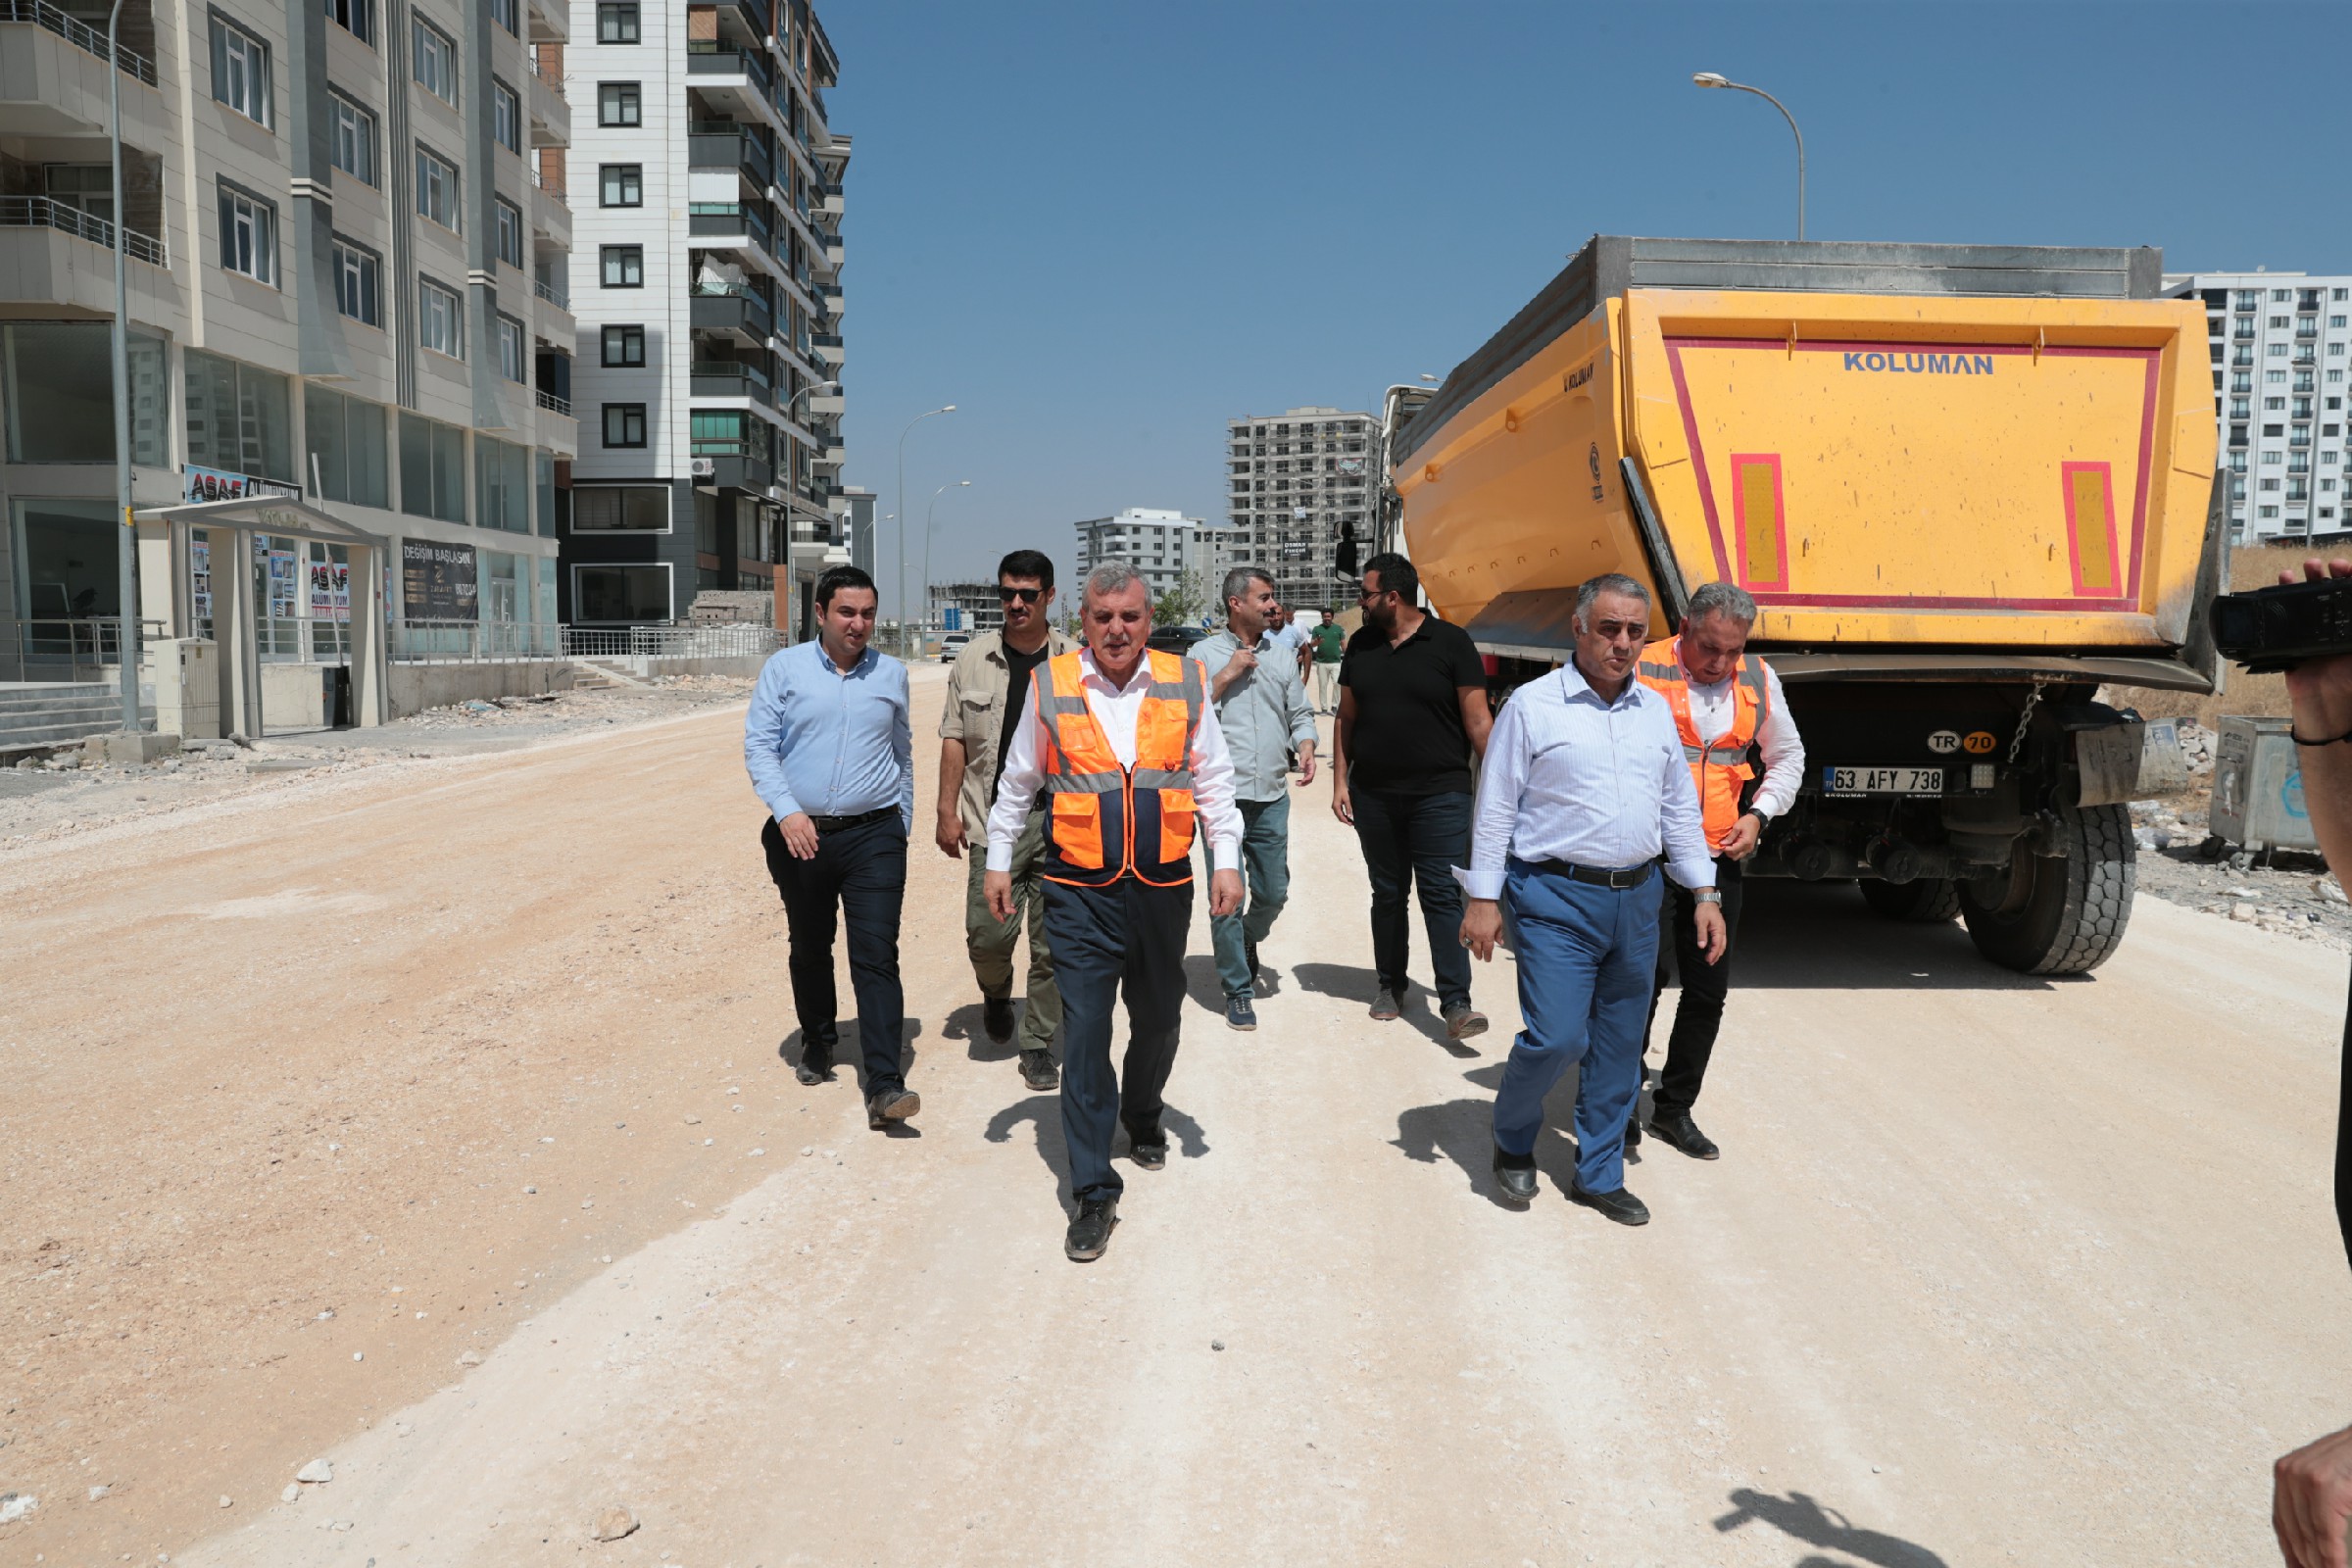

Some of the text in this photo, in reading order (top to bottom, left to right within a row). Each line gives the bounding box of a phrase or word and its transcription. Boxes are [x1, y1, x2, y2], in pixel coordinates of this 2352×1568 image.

[1843, 352, 1994, 375] KOLUMAN
[191, 473, 243, 502] ASAF
[403, 543, 471, 564] DEĞİŞİM BAŞLASIN
[311, 592, 348, 606] ALÜMİYUM
[1933, 735, 1956, 749] TR
[1969, 736, 1992, 750] 70
[1835, 769, 1856, 789] 63
[1866, 770, 1899, 791] AFY
[1909, 770, 1942, 791] 738
